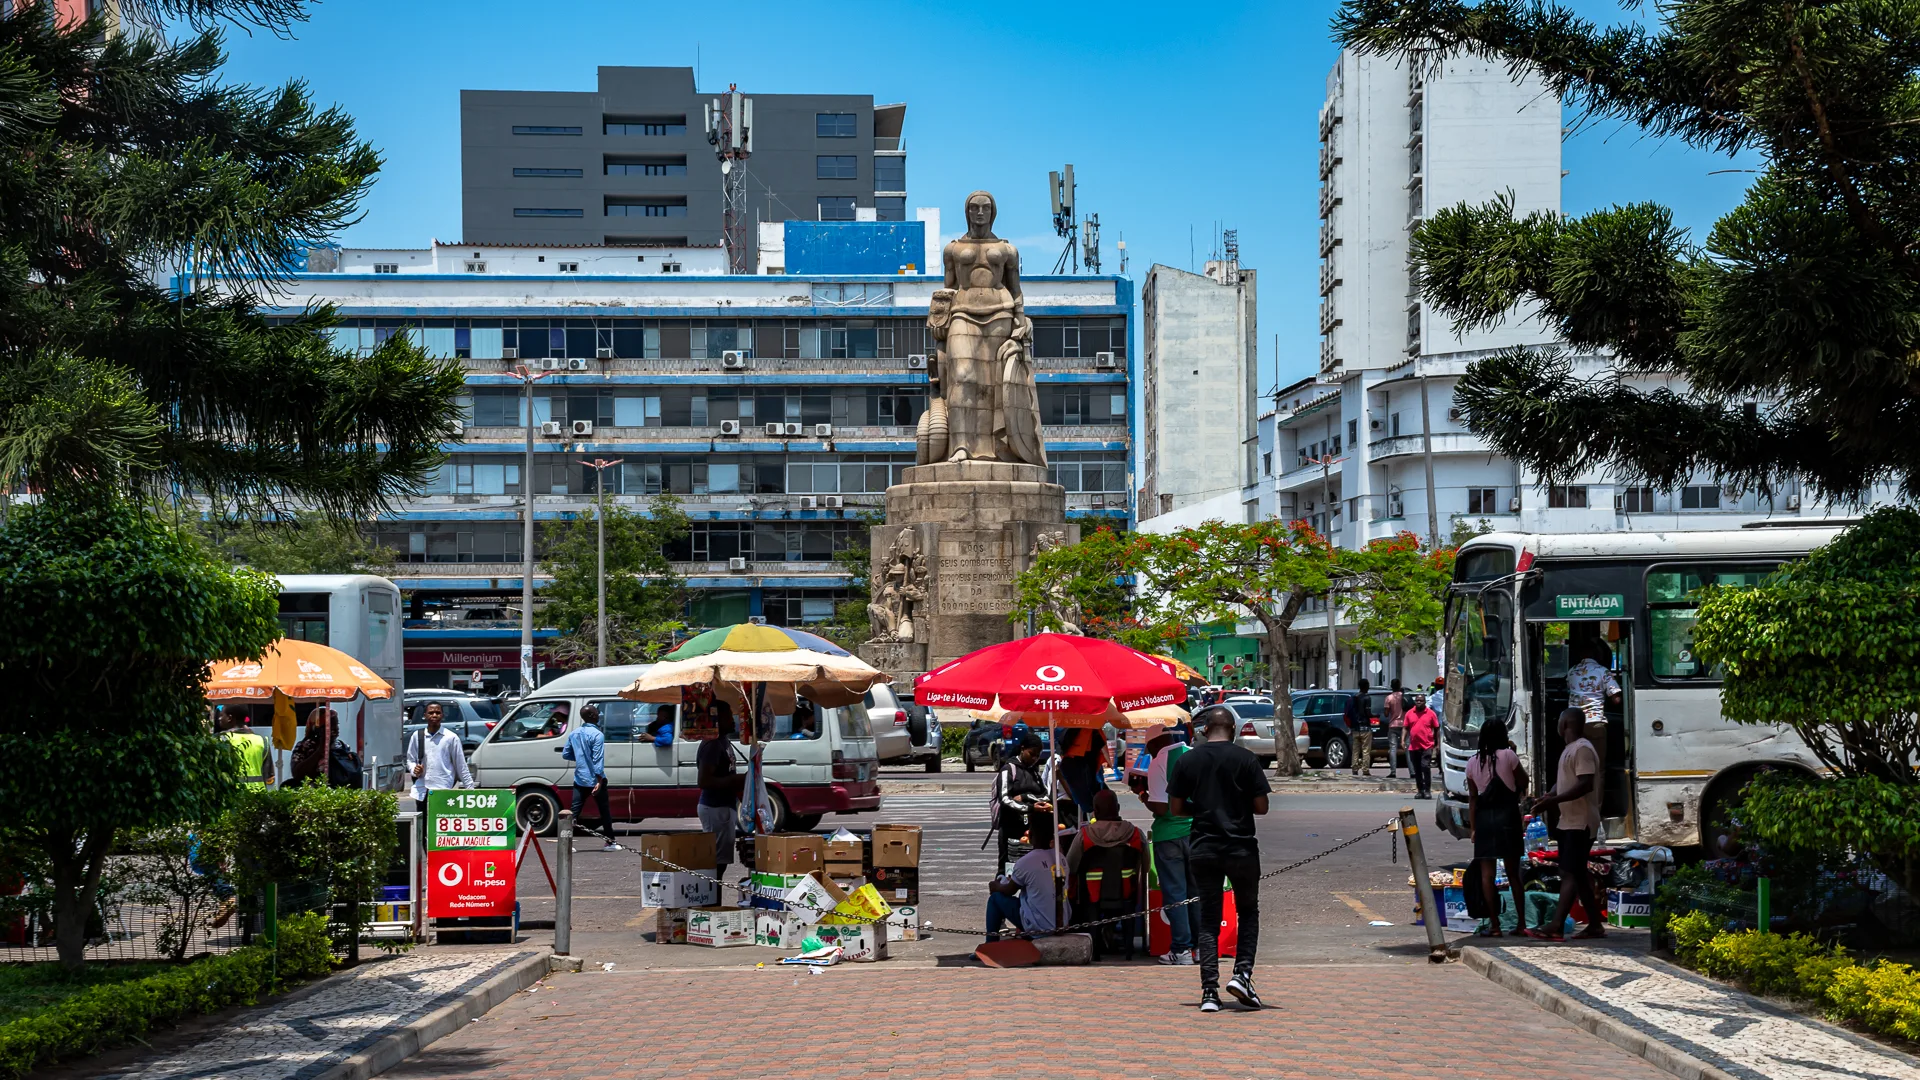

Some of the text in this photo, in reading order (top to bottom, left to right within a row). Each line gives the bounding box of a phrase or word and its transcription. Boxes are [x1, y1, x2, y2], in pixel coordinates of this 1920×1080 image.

[940, 559, 958, 567] SEUS
[1560, 597, 1619, 608] ENTRADA
[442, 651, 502, 663] Millennium
[1019, 682, 1083, 692] vodacom
[926, 692, 988, 706] Liga-te à Vodacom
[1120, 693, 1175, 711] Liga-te à Vodacom
[439, 818, 504, 832] 88556
[437, 836, 491, 847] BANCA MAGULE
[473, 879, 506, 888] m-pesa
